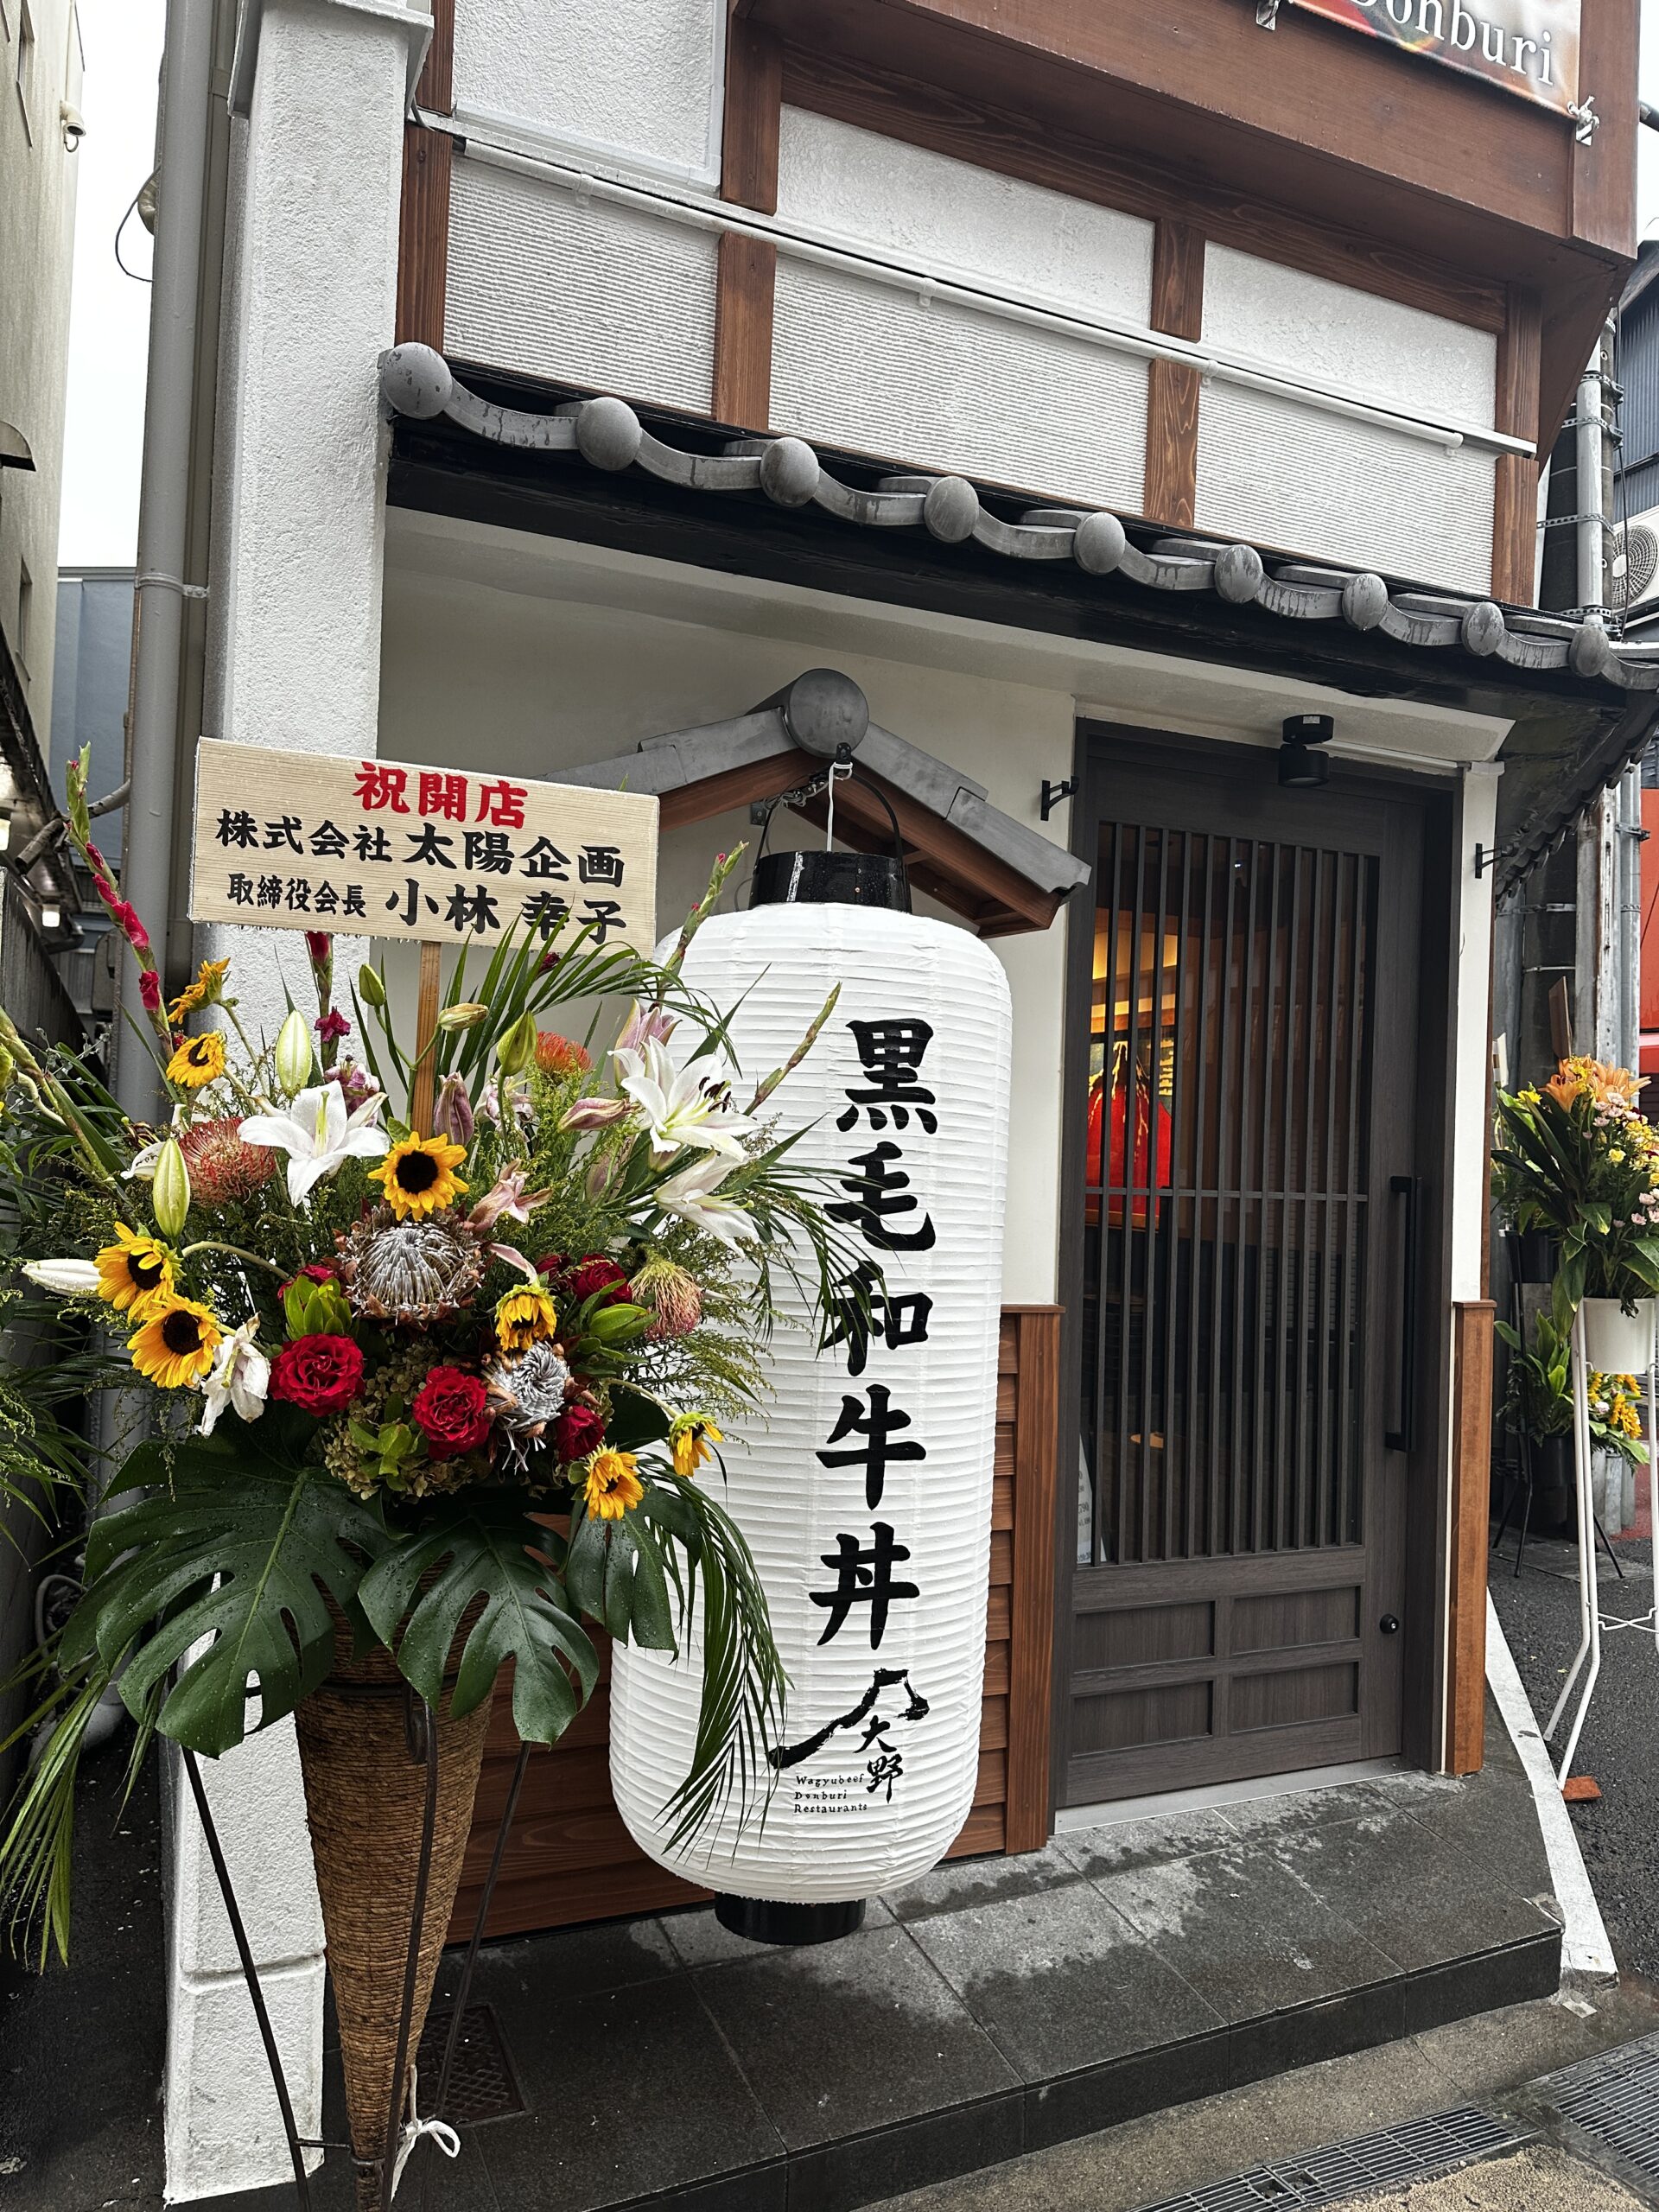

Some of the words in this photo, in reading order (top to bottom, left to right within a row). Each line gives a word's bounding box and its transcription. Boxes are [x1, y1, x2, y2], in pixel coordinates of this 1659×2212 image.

[1349, 0, 1554, 86] onburi
[353, 761, 529, 830] 祝開店
[214, 808, 626, 888] 株式会社太陽企画
[226, 873, 367, 918] 取締役会長
[809, 1018, 938, 1650] 黒毛和牛丼
[794, 1789, 847, 1800] Donburi
[853, 1714, 904, 1804] 大野
[793, 1802, 868, 1814] Restaurants
